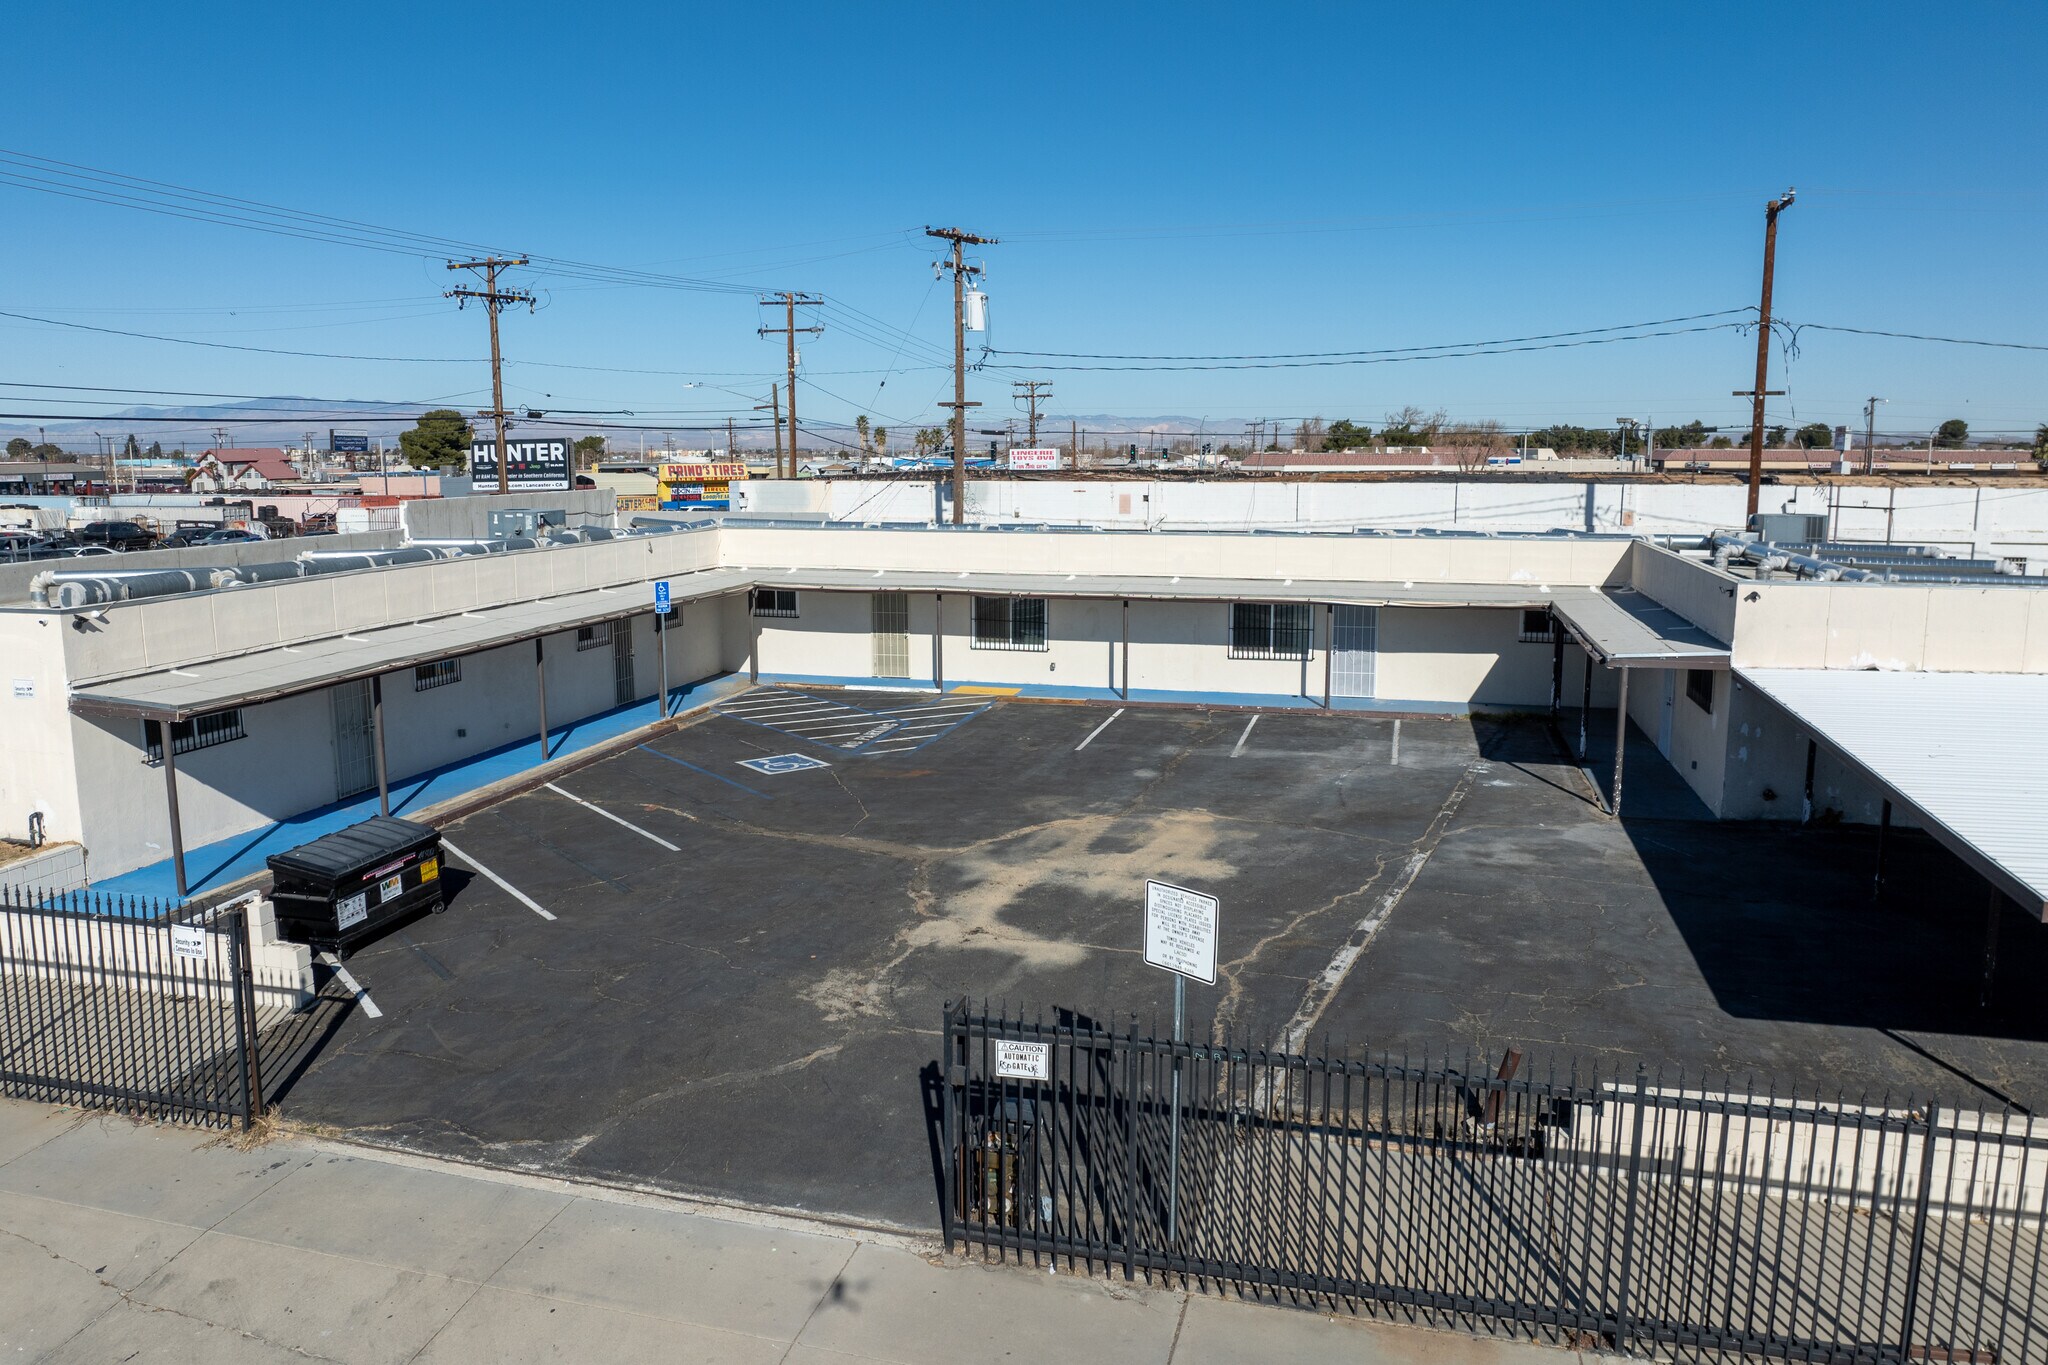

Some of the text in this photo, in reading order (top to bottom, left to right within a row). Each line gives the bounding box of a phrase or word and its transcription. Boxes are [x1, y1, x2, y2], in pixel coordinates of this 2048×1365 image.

[474, 443, 564, 462] HUNTER
[711, 464, 745, 476] TIRES
[381, 877, 399, 890] WM
[1009, 1044, 1043, 1052] CAUTION
[1004, 1053, 1039, 1062] AUTOMATIC
